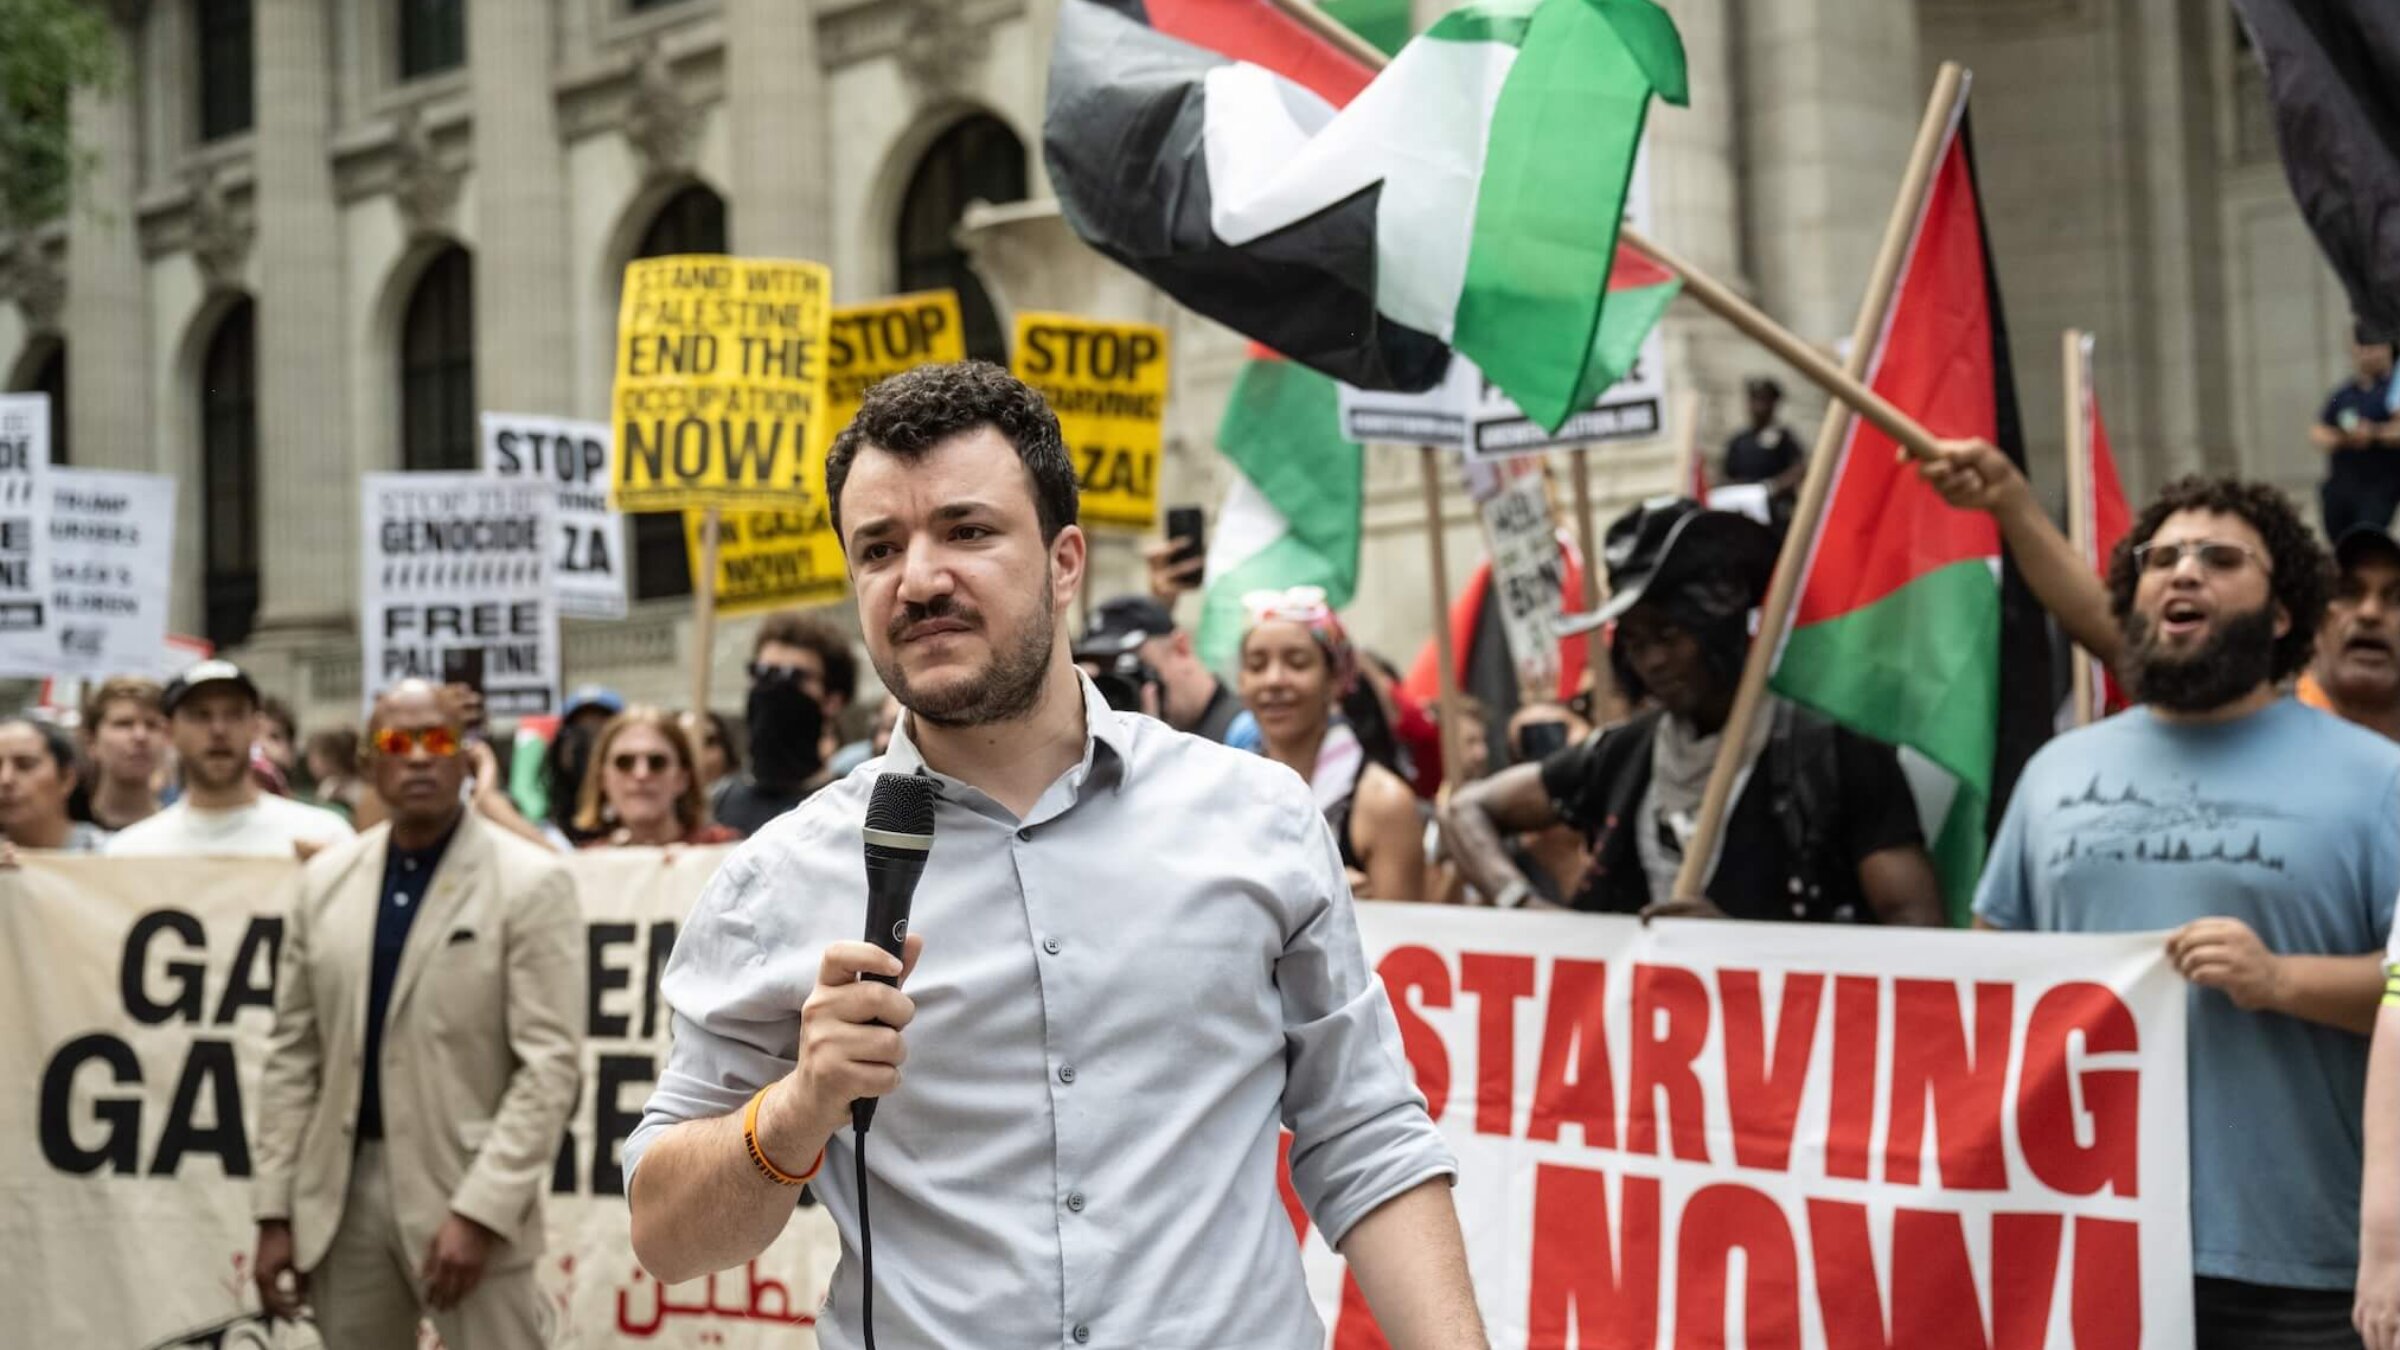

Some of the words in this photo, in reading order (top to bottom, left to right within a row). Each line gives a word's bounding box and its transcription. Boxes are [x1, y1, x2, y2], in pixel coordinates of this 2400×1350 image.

[637, 266, 734, 290] STAND
[744, 268, 821, 292] WITH
[629, 334, 718, 378] END
[740, 336, 817, 381] THE
[828, 304, 947, 368] STOP
[1024, 323, 1159, 384] STOP
[622, 388, 811, 416] OCCUPATION
[497, 430, 605, 483] STOP
[624, 416, 806, 484] NOW!
[380, 514, 538, 553] GENOCIDE
[385, 602, 539, 638] FREE
[1376, 945, 2140, 1199] STARVING
